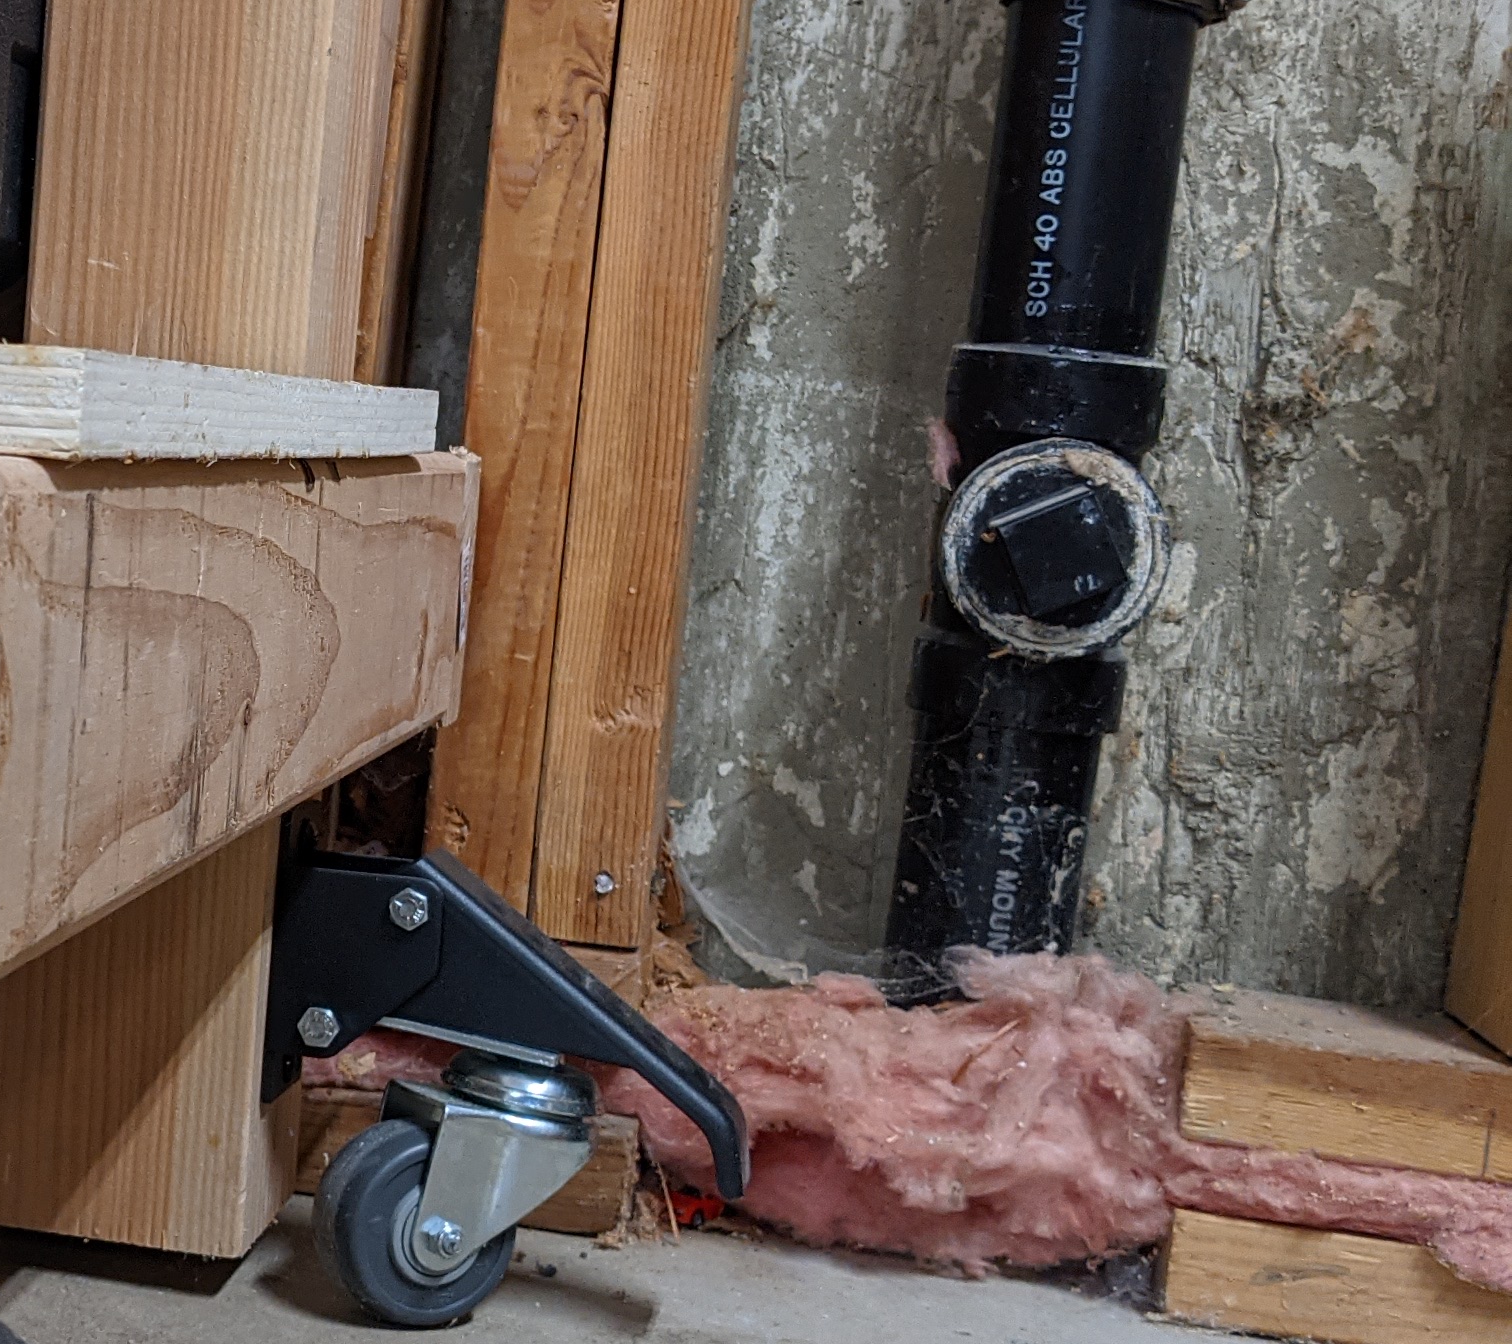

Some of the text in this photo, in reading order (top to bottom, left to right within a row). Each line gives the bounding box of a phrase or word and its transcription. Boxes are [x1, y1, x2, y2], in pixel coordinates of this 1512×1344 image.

[1039, 149, 1067, 206] ABS
[1033, 214, 1059, 253] 40
[1024, 260, 1053, 317] SCH
[986, 869, 1020, 954] MOUN
